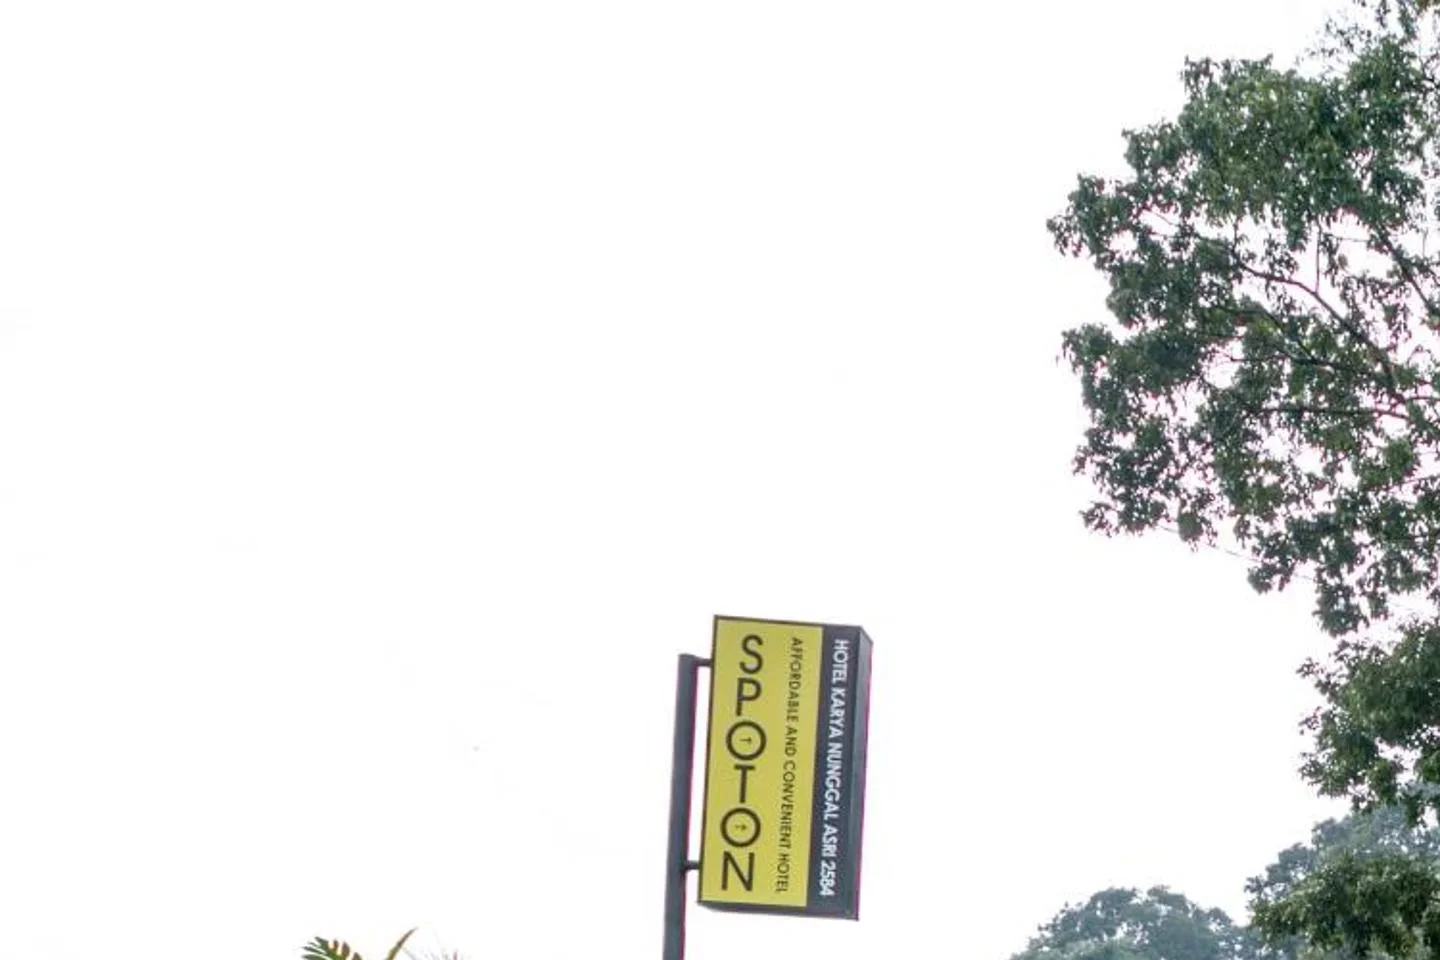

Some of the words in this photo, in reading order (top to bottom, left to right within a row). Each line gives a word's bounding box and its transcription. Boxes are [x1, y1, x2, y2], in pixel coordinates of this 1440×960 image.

[786, 636, 803, 723] AFFORDABLE
[831, 638, 851, 684] HOTEL
[827, 686, 847, 739] KARYA
[783, 727, 798, 755] AND
[778, 759, 797, 848] CONVENIENT
[822, 742, 845, 820] NUNGGAL
[821, 823, 840, 856] ASRI
[775, 852, 790, 894] HOTEL
[818, 857, 837, 896] 2584
